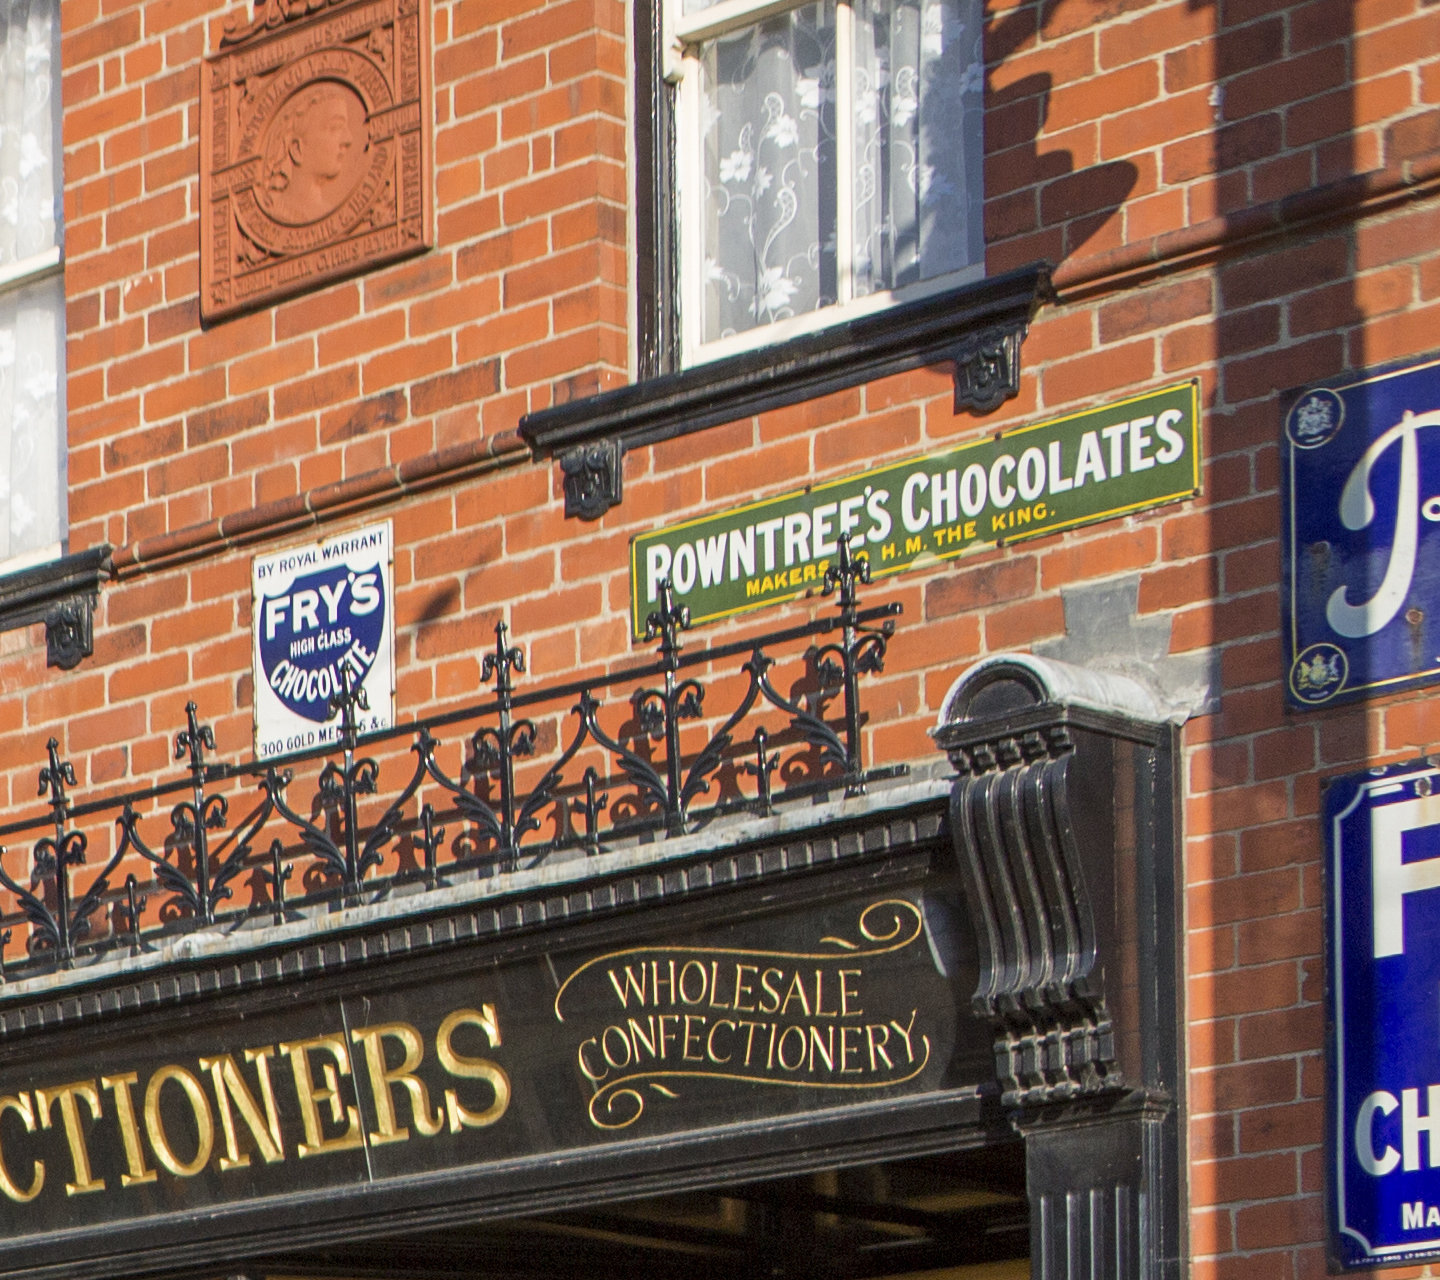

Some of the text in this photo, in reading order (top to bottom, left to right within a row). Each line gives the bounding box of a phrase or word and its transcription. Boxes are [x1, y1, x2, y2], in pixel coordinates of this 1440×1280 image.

[647, 487, 892, 603] ROWNTREE'S
[901, 409, 1183, 534] CHOCOLATES
[258, 530, 384, 579] BY ROYAL WARRANT
[746, 560, 830, 597] MAKERS
[881, 533, 927, 563] H.M.
[935, 522, 977, 548] THE
[266, 571, 380, 641] FRY'S
[290, 626, 352, 659] HIGH CLASS
[287, 732, 314, 750] GOLD
[319, 719, 367, 743] MEDS
[607, 960, 863, 1018] WHOLESALE
[578, 1008, 918, 1081] CONFECTIONERY
